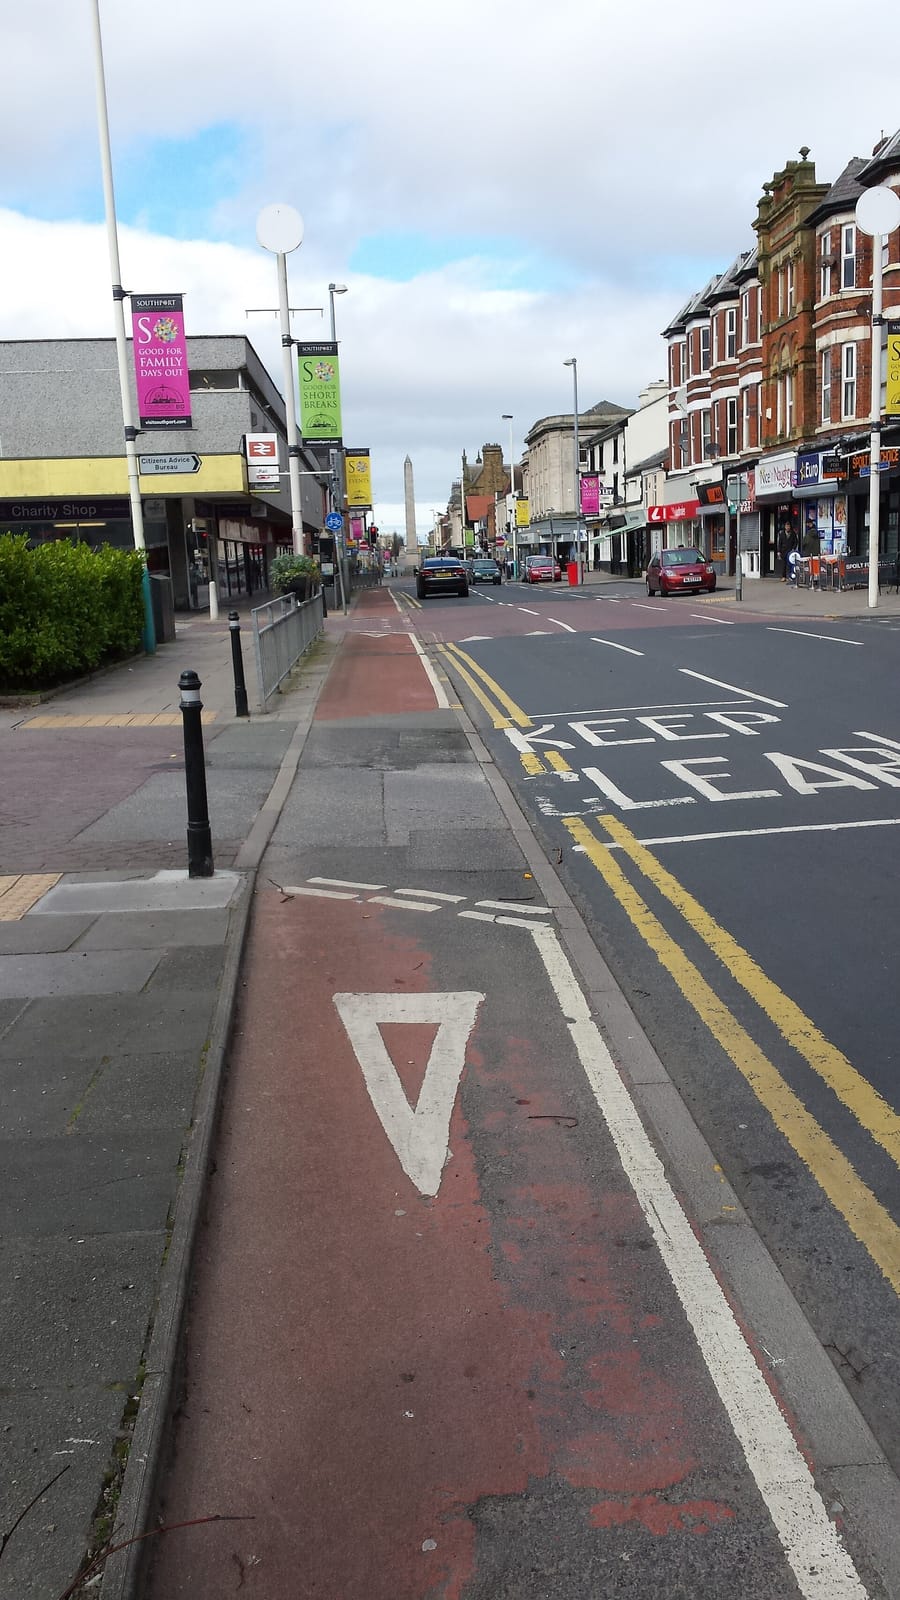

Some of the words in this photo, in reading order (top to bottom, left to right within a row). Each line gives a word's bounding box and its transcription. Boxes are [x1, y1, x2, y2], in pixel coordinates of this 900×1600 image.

[136, 299, 176, 307] SOUTHPORT
[166, 347, 183, 355] FOR
[140, 356, 183, 367] FAMILY
[140, 369, 162, 377] DAYS
[164, 368, 184, 377] OUT
[303, 391, 337, 400] SHORT
[304, 400, 338, 409] BREAKS
[168, 456, 190, 464] Advice
[805, 461, 819, 478] Euro
[11, 504, 58, 518] Charity
[62, 503, 97, 517] Shop
[503, 711, 782, 753] KEEP
